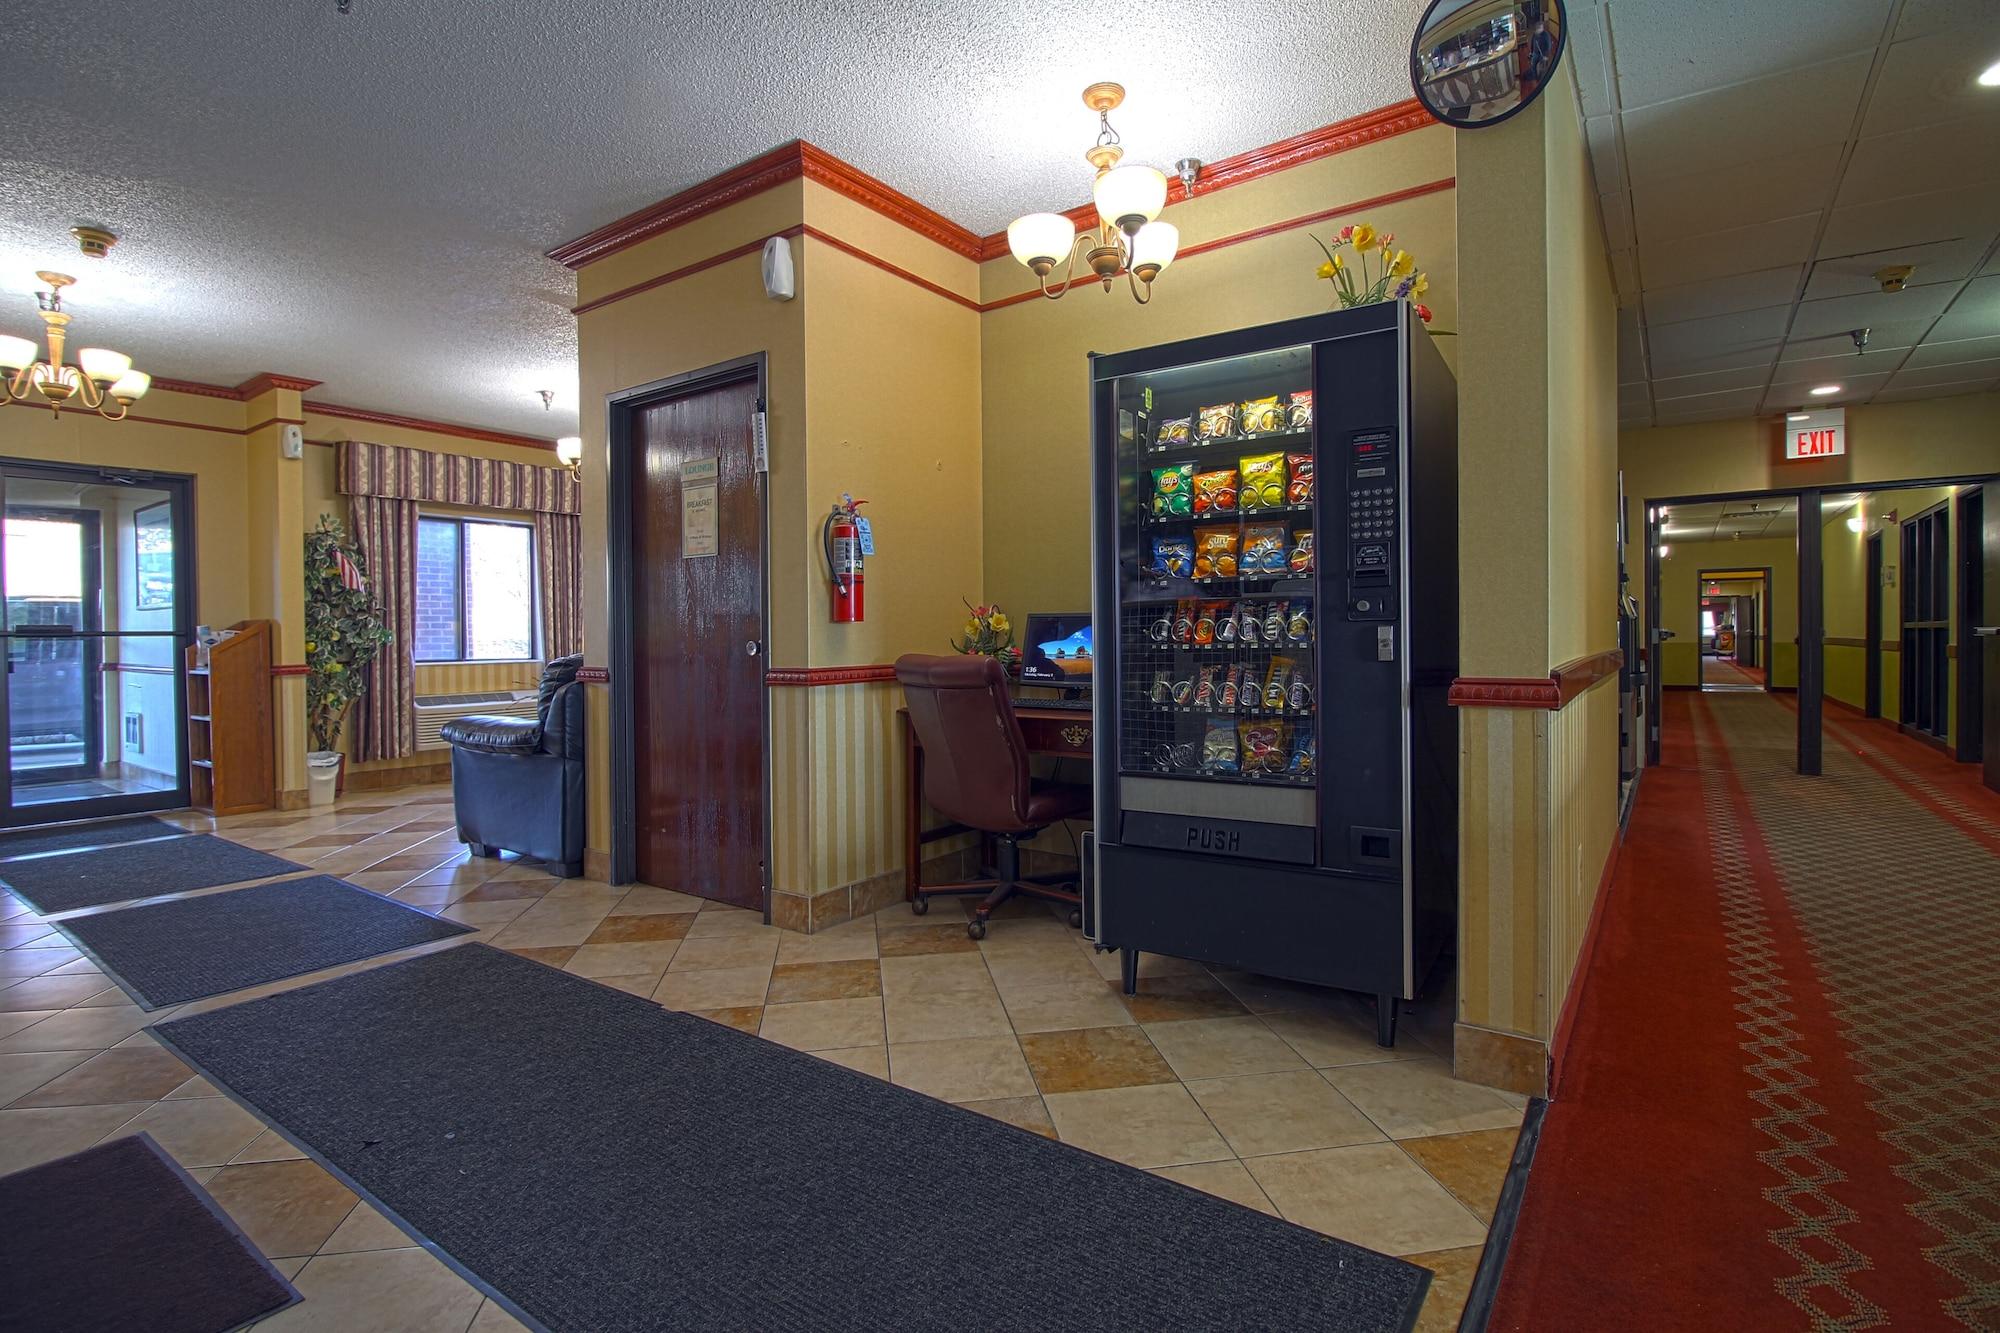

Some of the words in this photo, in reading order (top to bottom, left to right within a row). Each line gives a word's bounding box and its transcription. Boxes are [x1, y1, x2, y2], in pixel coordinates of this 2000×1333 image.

[1797, 430, 1835, 456] EXIT
[685, 463, 715, 475] LOUNGE
[687, 499, 712, 509] BREAKFAST
[1187, 827, 1240, 851] PUSH
